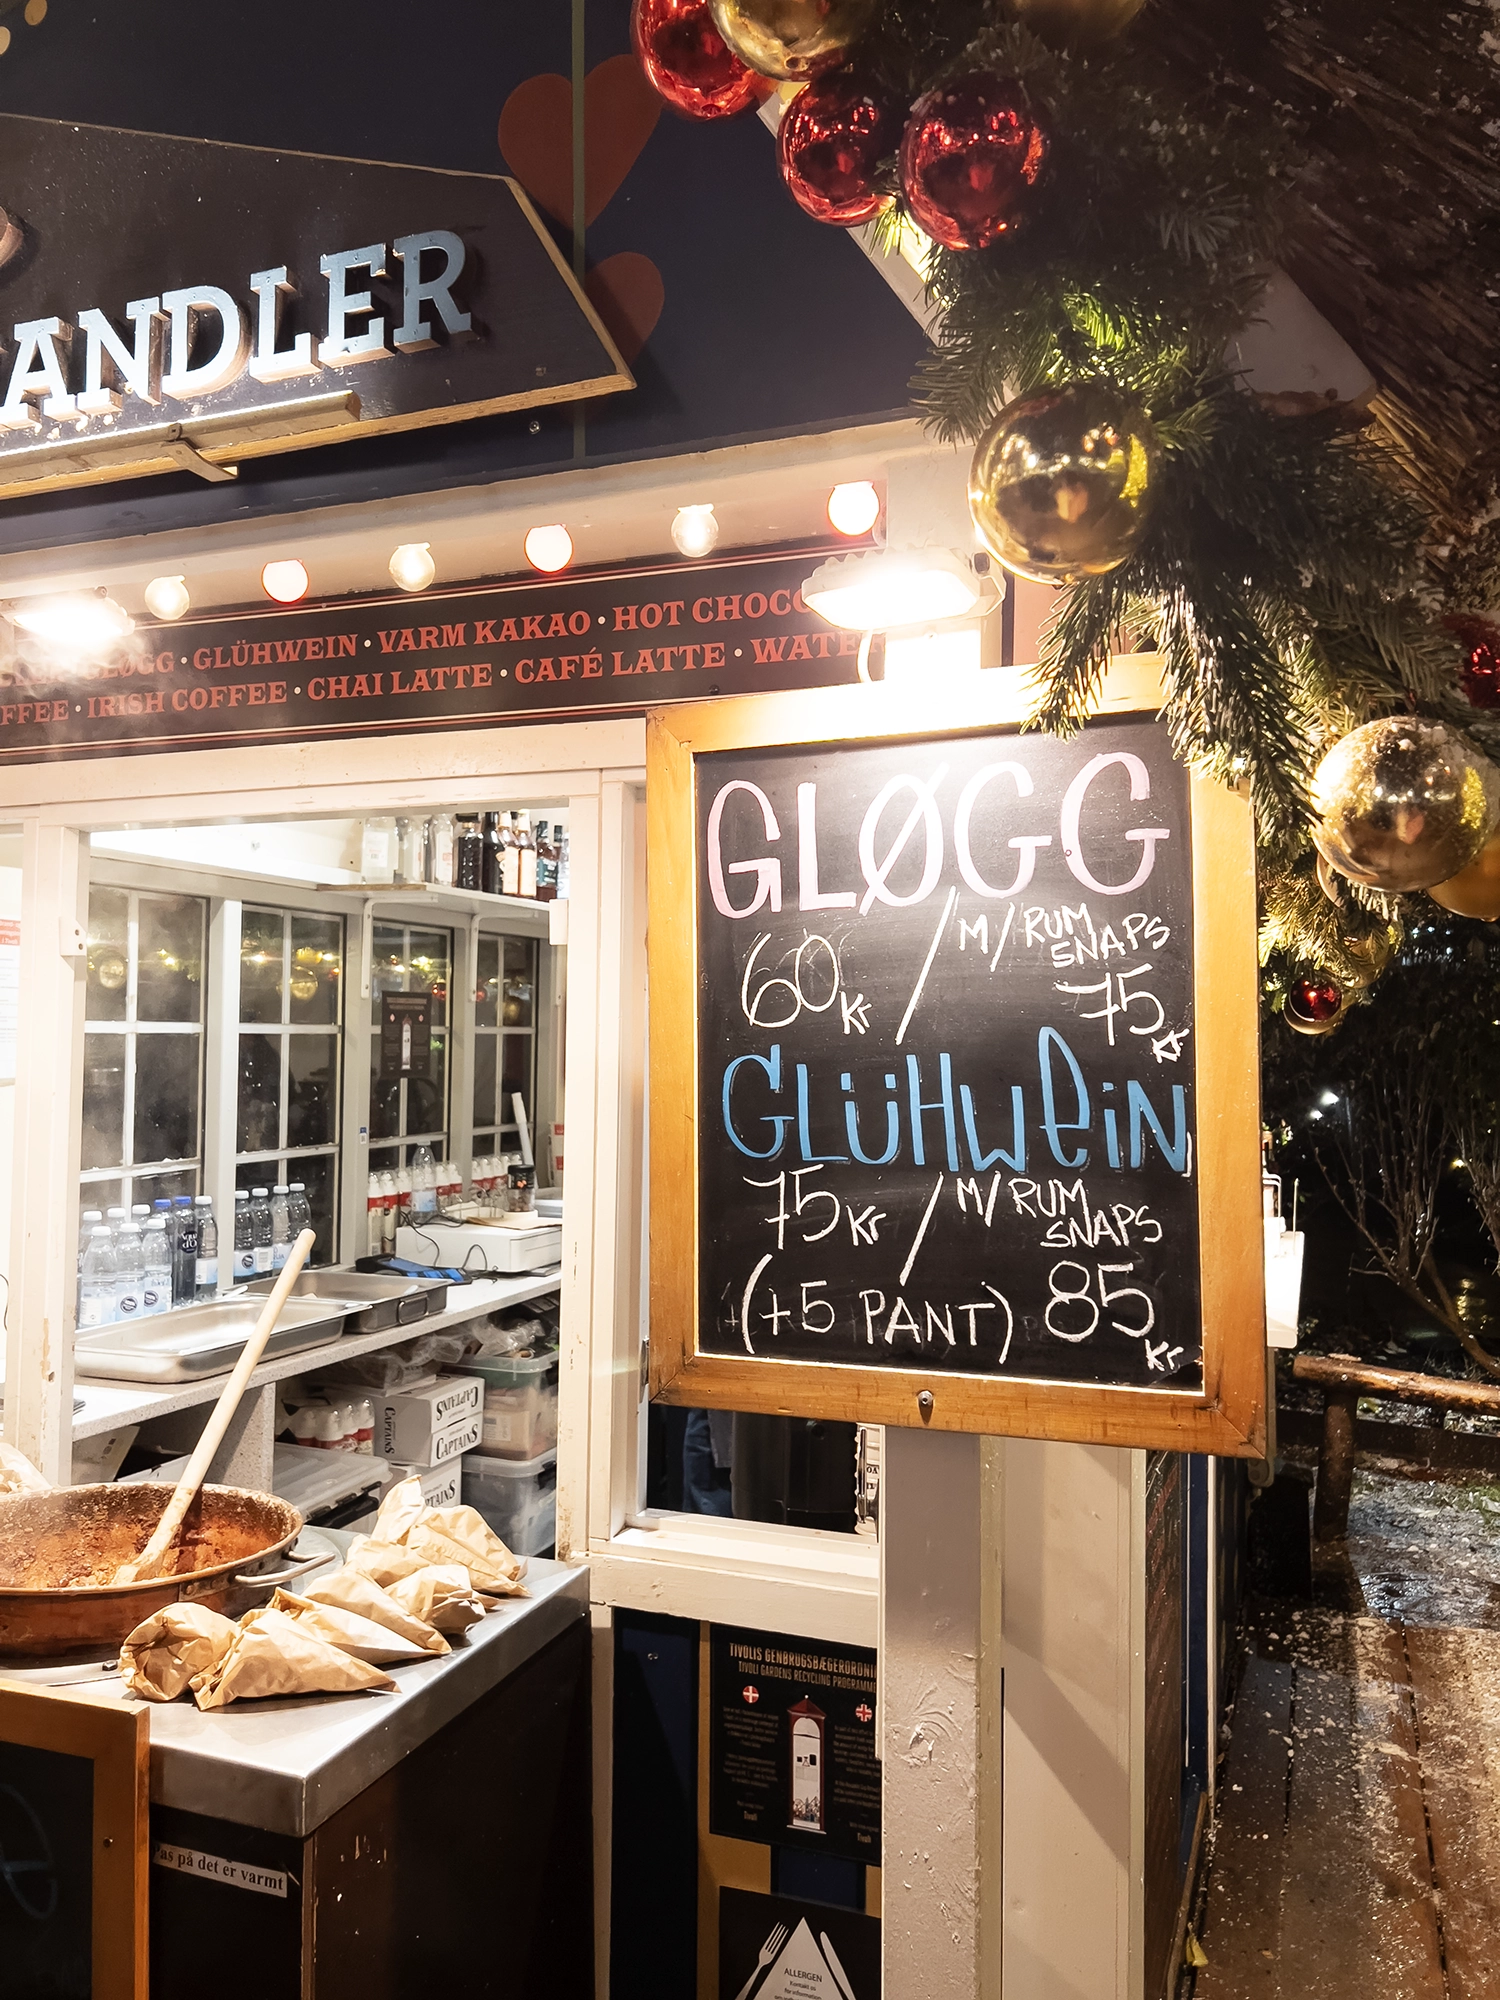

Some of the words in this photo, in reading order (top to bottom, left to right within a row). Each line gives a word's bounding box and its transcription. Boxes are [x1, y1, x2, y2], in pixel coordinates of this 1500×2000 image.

[88, 651, 174, 680] LØGG
[193, 634, 358, 670] GLÜHWEIN
[377, 623, 467, 654] VARM
[473, 610, 591, 645] KAKAO
[612, 600, 685, 632] HOT
[87, 691, 166, 719] IRISH
[171, 681, 287, 712] COFFEE
[307, 672, 385, 701] CHAI
[390, 663, 492, 695] LATTE
[514, 646, 603, 684] CAFÉ
[611, 642, 726, 677] LATTE
[706, 751, 1171, 919] GLØGG
[1051, 912, 1172, 969] SNAPS
[1039, 1203, 1164, 1249] SNAPS
[436, 1386, 479, 1421] CAPTAINS
[384, 1406, 396, 1454] CAPTAINS
[436, 1423, 478, 1460] CAPTAINS
[729, 1642, 763, 1661] TIVOLIS
[738, 1660, 759, 1675] TIVOLI
[760, 1664, 793, 1681] GARDENS
[793, 1669, 831, 1687] RECYCLING
[177, 1850, 194, 1868] på
[197, 1855, 220, 1874] det
[222, 1864, 237, 1878] er
[240, 1868, 284, 1890] varmt
[783, 1967, 823, 1983] ALLERGEN
